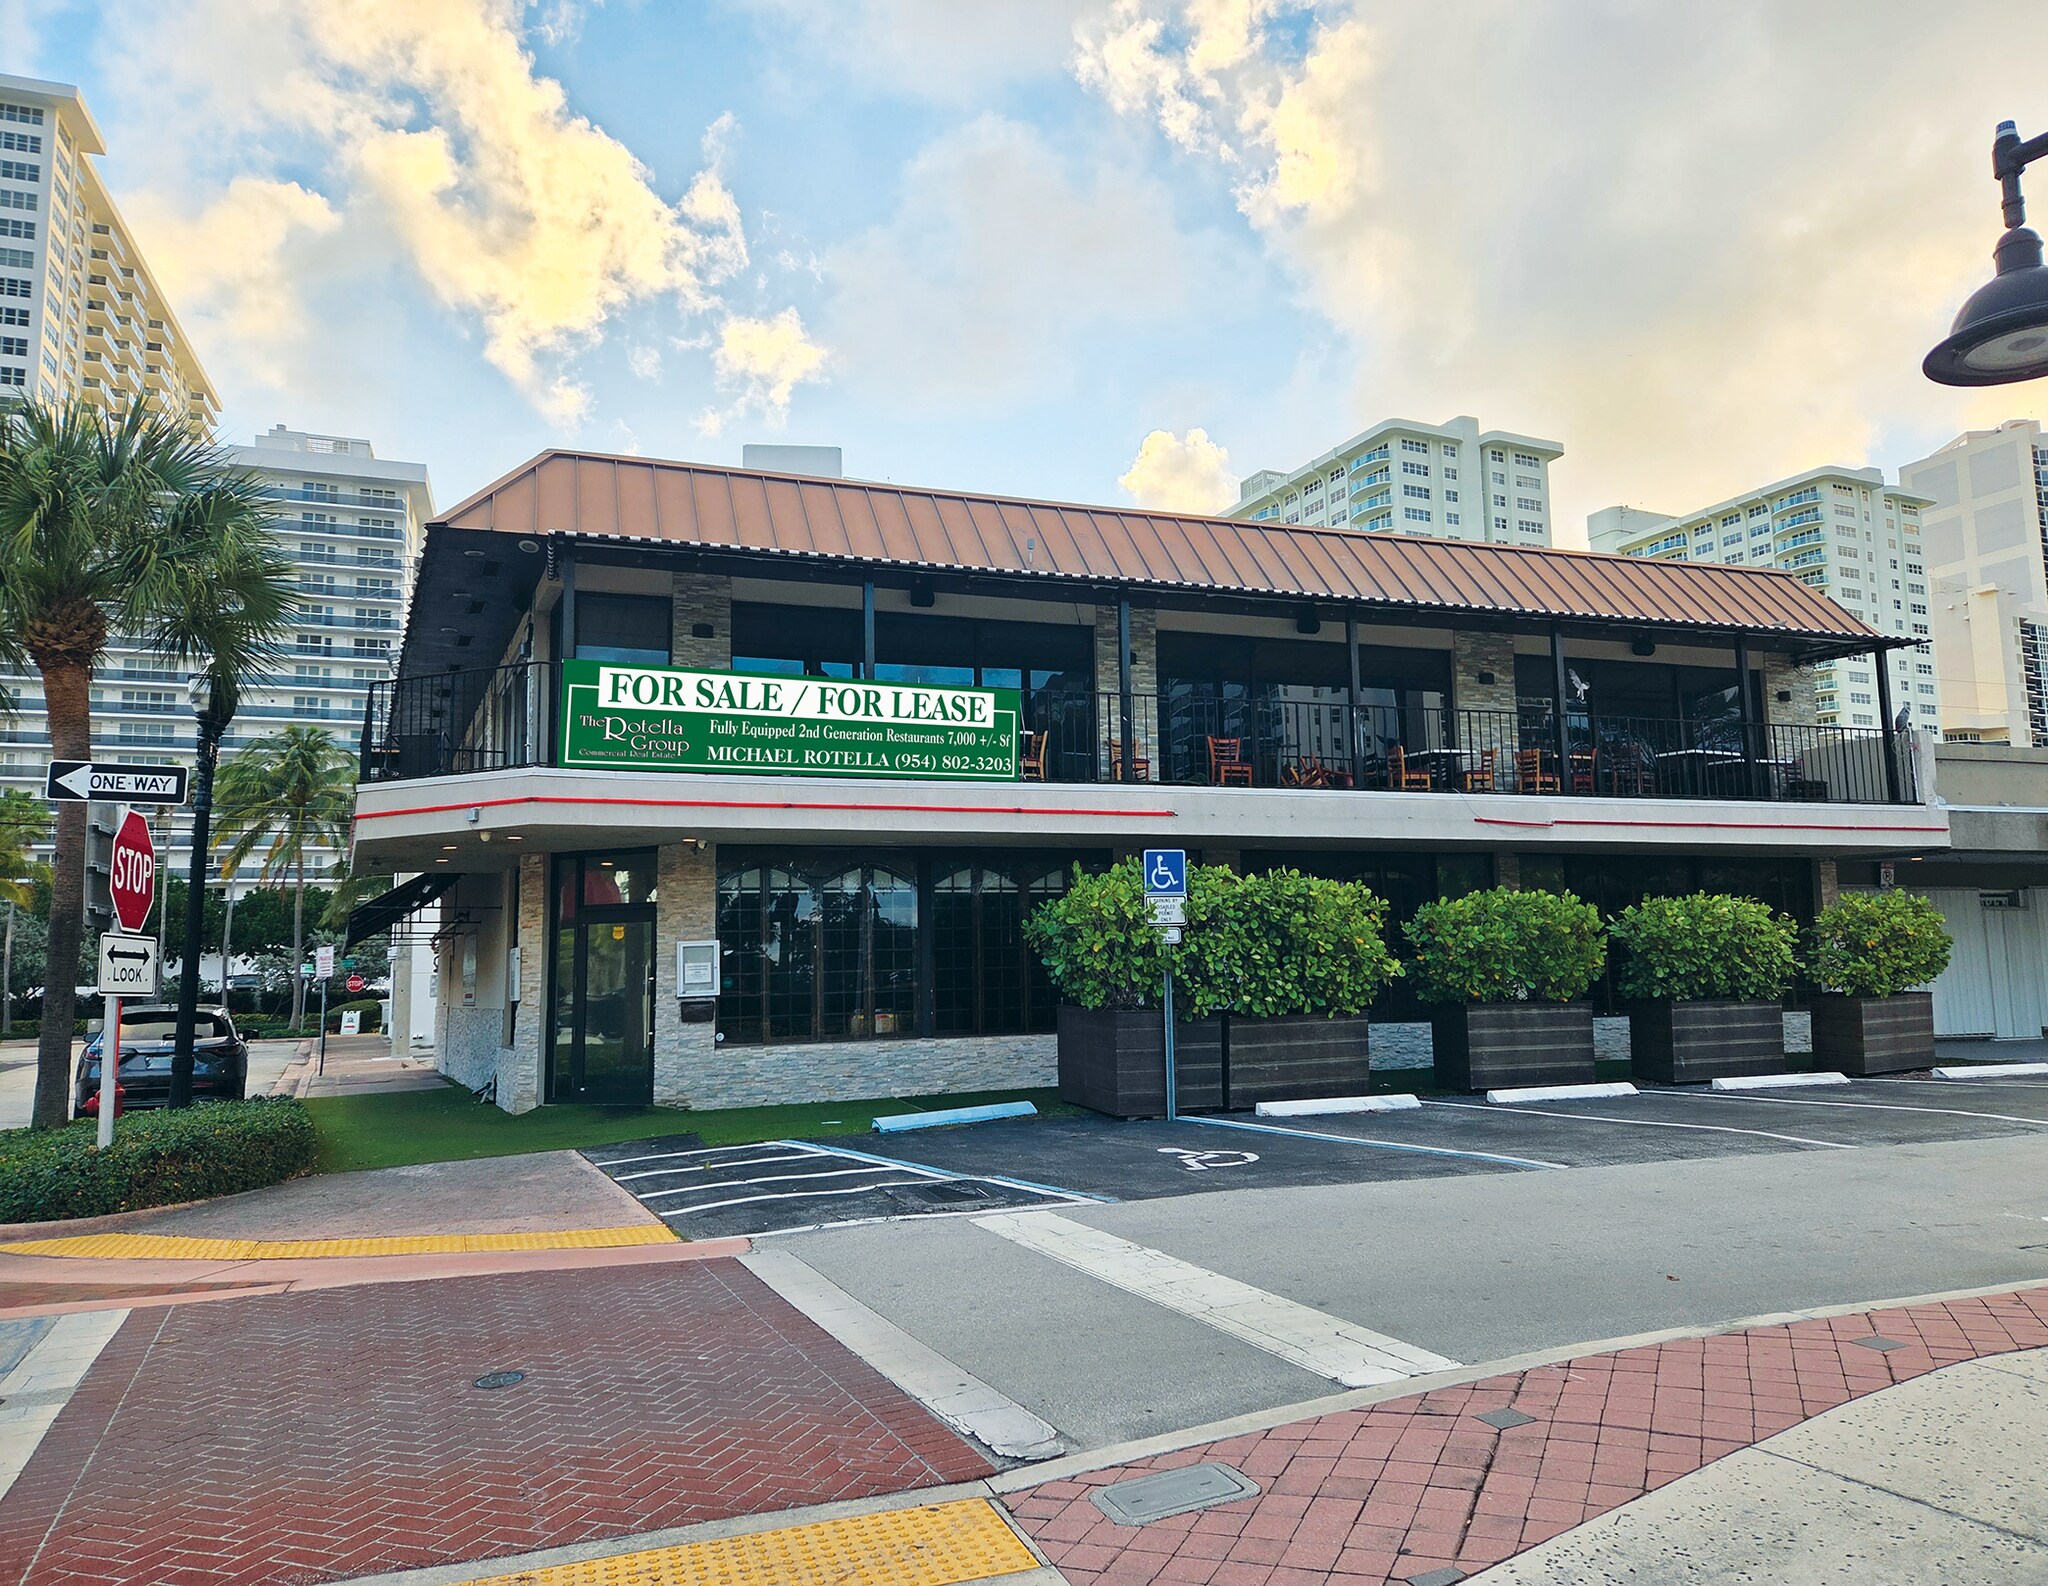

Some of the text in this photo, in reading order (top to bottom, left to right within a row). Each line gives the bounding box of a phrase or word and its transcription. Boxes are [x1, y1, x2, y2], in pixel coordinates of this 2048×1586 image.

[608, 673, 987, 723] FOR SALE / FOR LEASE
[579, 715, 684, 741] The Rotella
[709, 719, 1011, 748] Fully Equipped 2nd Generation Restaurants 7,000 +/- Sf
[578, 748, 675, 759] Commercial Real Estate
[630, 735, 690, 757] Group
[706, 745, 1012, 772] MICHAEL ROTELLA (954) 802-3203
[90, 774, 172, 792] ONE WAY
[114, 845, 153, 895] STOP
[112, 966, 143, 983] LOOK
